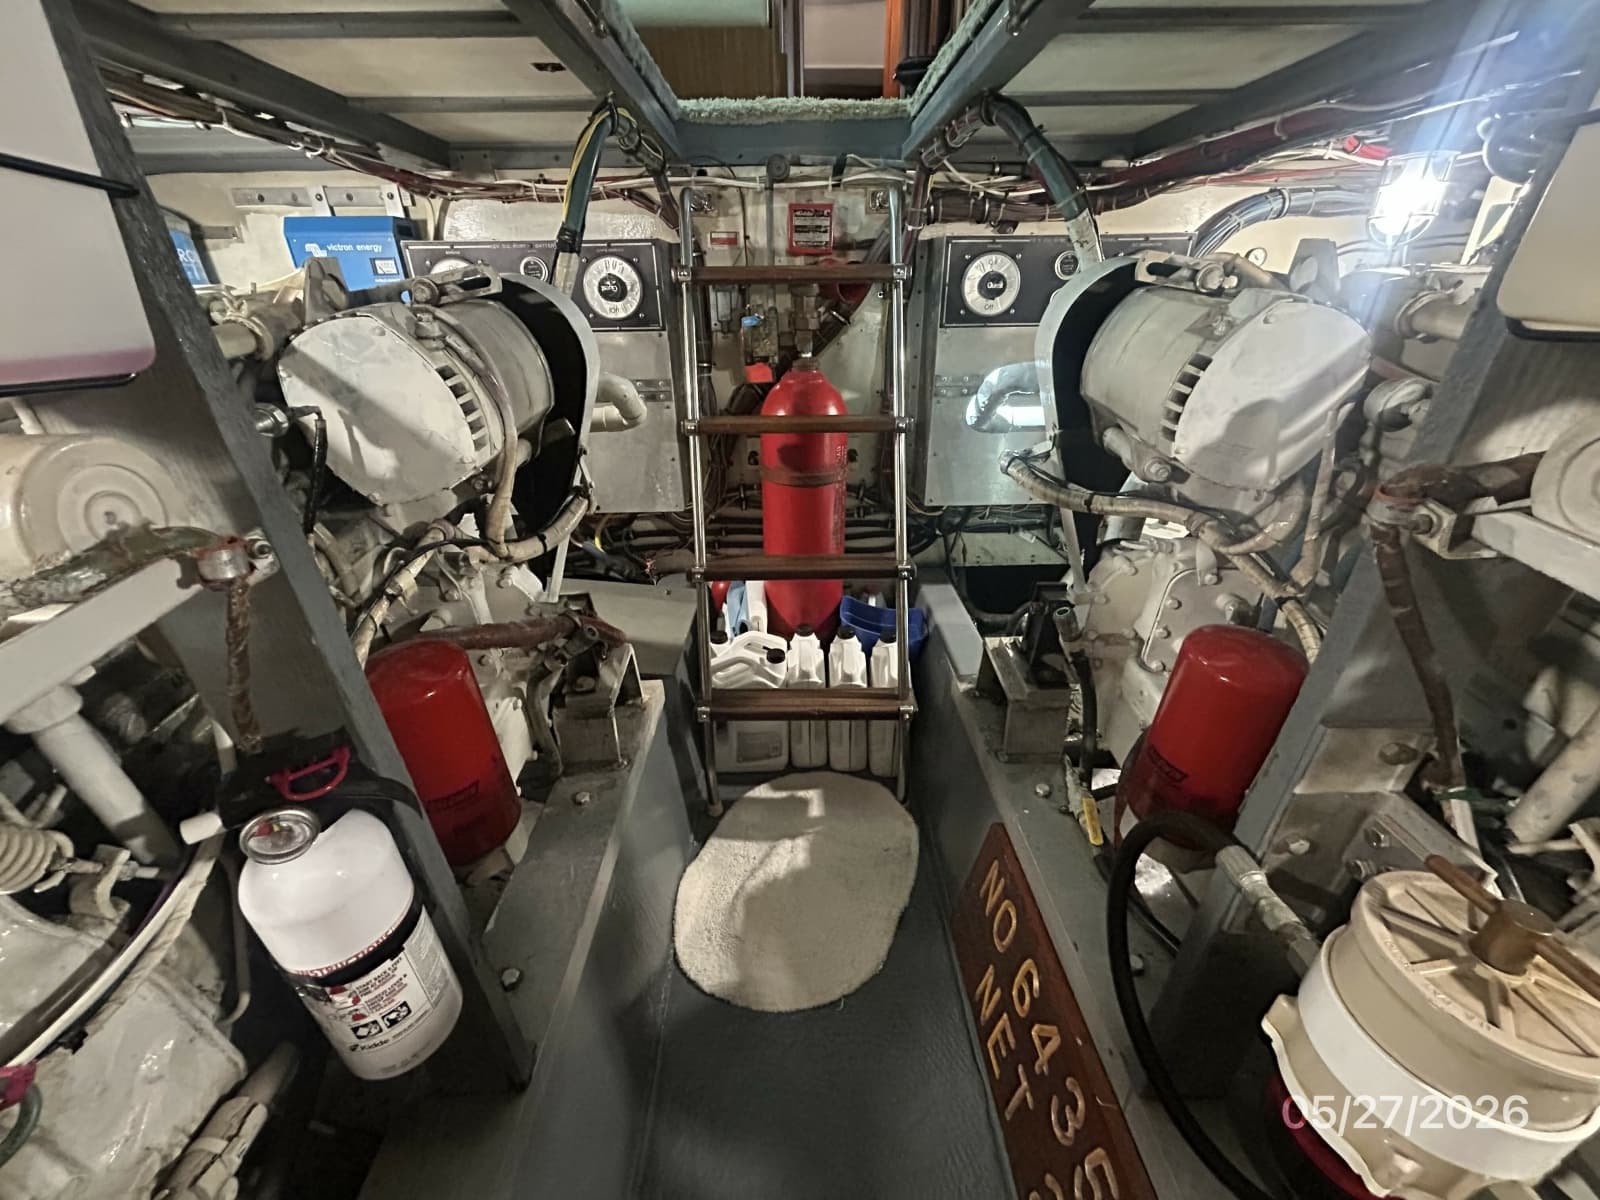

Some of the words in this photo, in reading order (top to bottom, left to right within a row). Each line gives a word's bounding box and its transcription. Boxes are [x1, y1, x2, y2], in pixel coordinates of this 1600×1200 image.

[326, 243, 353, 252] victron
[356, 244, 382, 253] energy
[979, 858, 1017, 953] NO
[975, 963, 1034, 1121] NET
